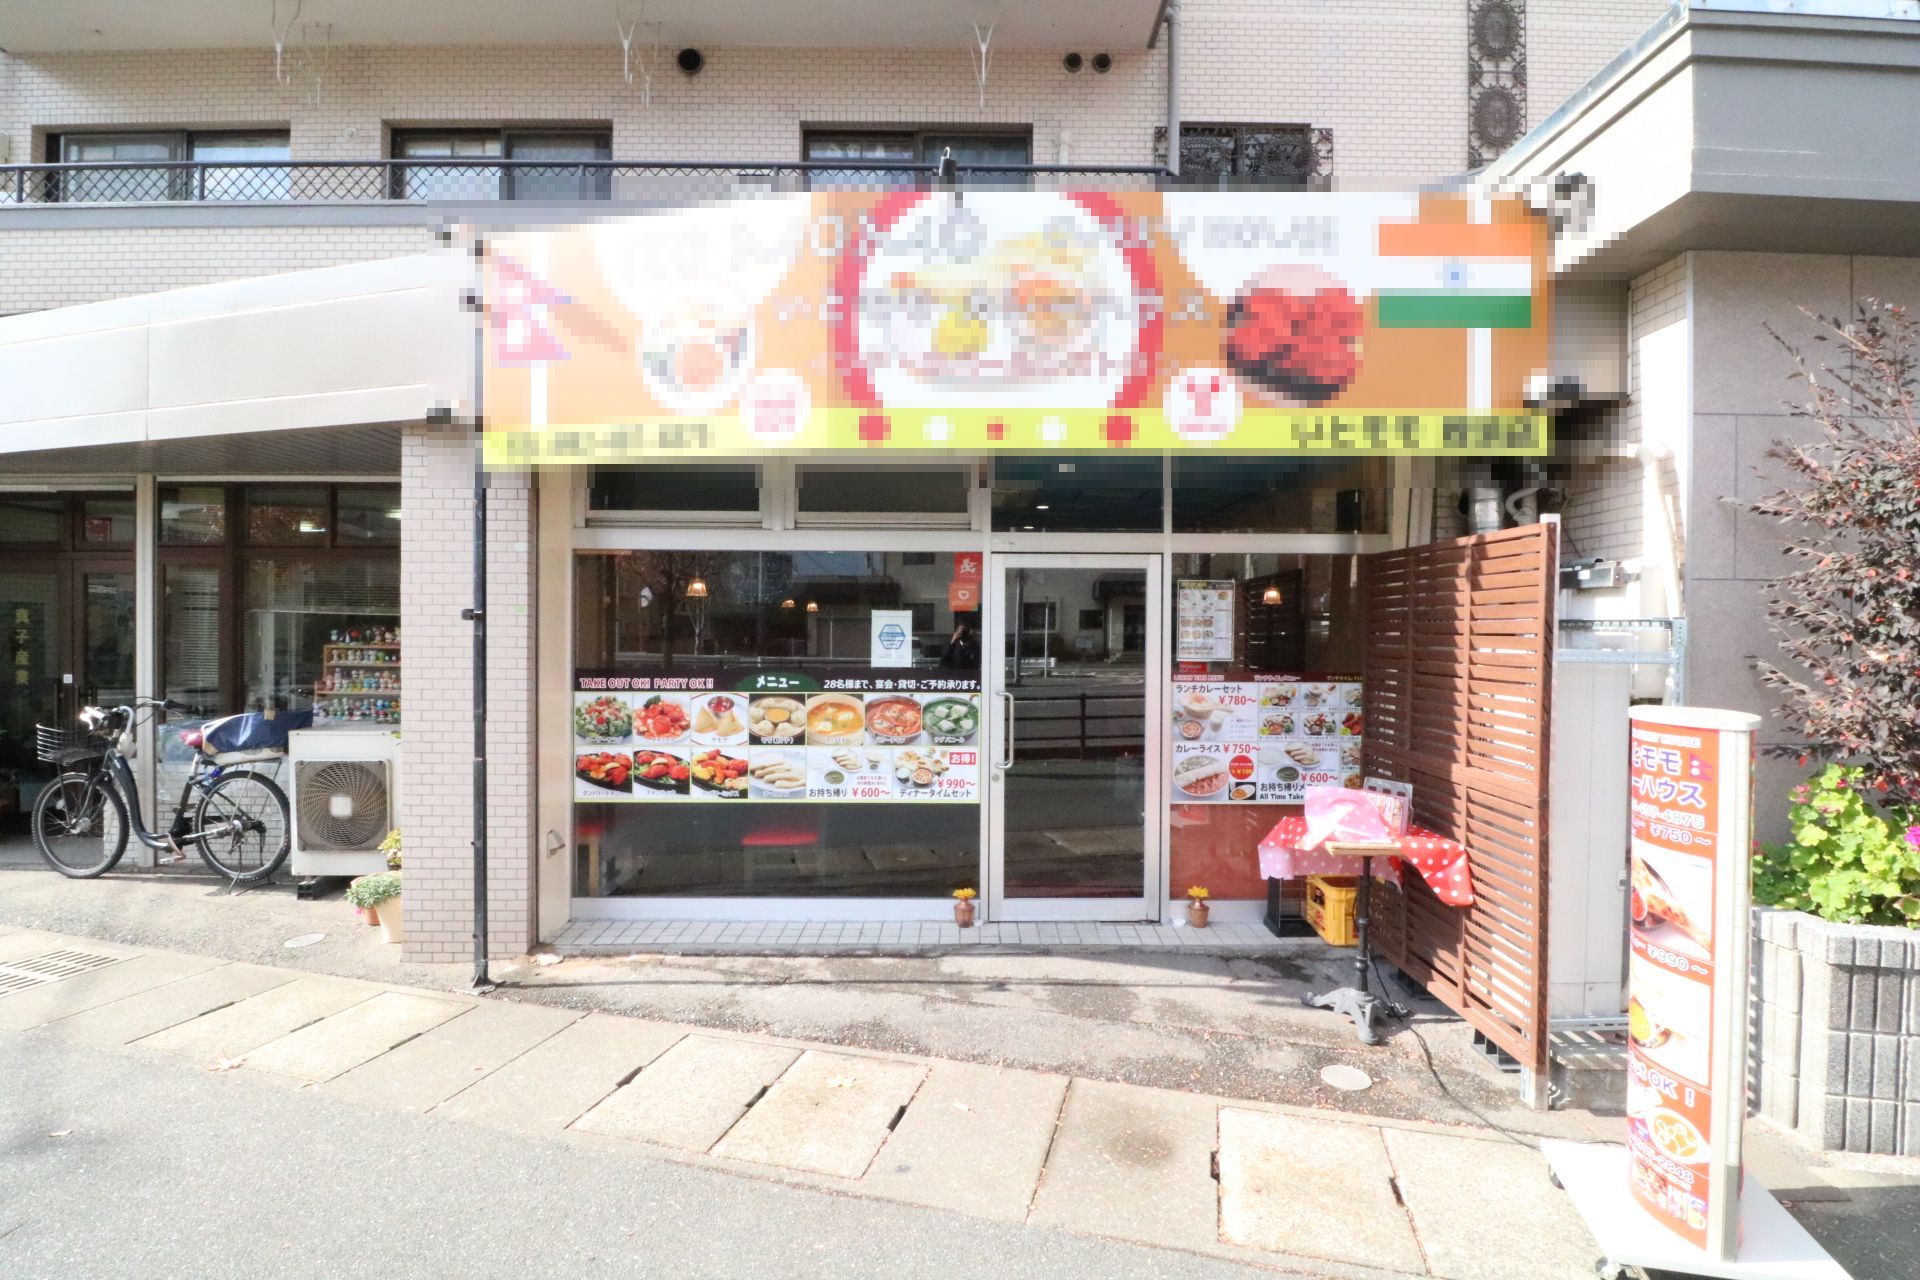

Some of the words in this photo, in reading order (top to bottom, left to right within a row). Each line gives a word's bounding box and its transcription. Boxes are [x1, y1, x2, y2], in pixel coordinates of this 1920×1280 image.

[579, 678, 607, 689] TAKE
[607, 678, 631, 689] OUT
[631, 678, 651, 689] OK!
[654, 678, 688, 689] PARTY
[688, 678, 705, 689] OK
[756, 675, 800, 688] メニュー
[1175, 684, 1242, 694] ランチカレーセット
[1175, 744, 1221, 754] カレーライス
[950, 753, 976, 765] お得!
[1259, 782, 1319, 793] お持ち帰りメ
[808, 789, 848, 798] お持ち帰り
[899, 789, 972, 798] ディナータイムセット
